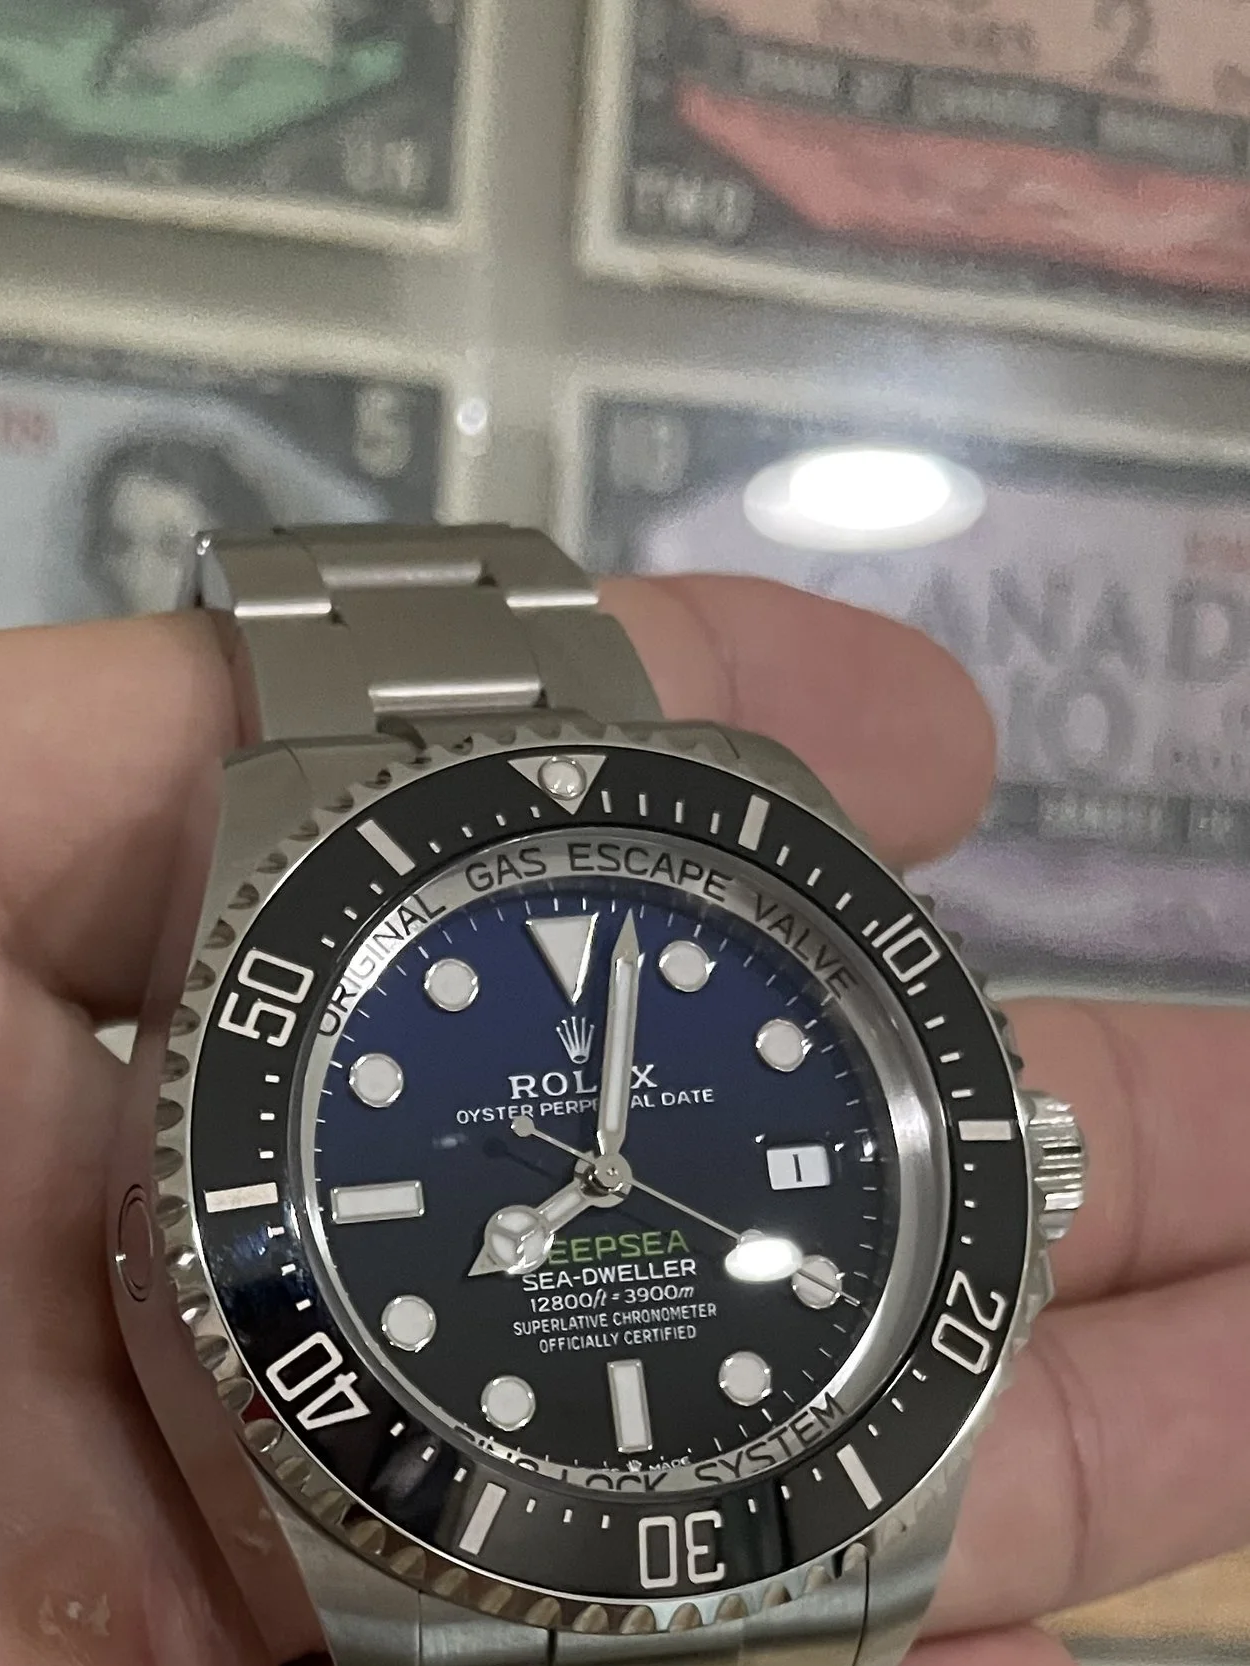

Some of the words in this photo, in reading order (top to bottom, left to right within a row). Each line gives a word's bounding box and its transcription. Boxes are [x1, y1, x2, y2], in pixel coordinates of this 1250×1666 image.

[810, 555, 1250, 686] ANAD
[317, 893, 447, 1037] ORIGINAL
[465, 847, 548, 893] GAS
[567, 842, 736, 903] ESCAPE
[751, 893, 860, 1001] VALVE
[871, 913, 941, 984] 10
[218, 947, 315, 1048] 50
[456, 1103, 534, 1125] OYSTER
[539, 1093, 656, 1117] PERPAL
[661, 1088, 715, 1107] DATE
[508, 1064, 658, 1101] ROLX
[522, 1259, 697, 1293] SEA-DWELLER
[549, 1230, 690, 1264] EEPSEA
[513, 1314, 609, 1337] SUPERLATIVE
[612, 1303, 717, 1328] CHRONOMETER
[538, 1332, 620, 1354] OFFICIALLY
[623, 1326, 697, 1345] CERTIFIED
[931, 1270, 1007, 1375] 20
[266, 1331, 371, 1430] 40
[694, 1391, 849, 1484] SYSTEM
[638, 1510, 726, 1589] 30
